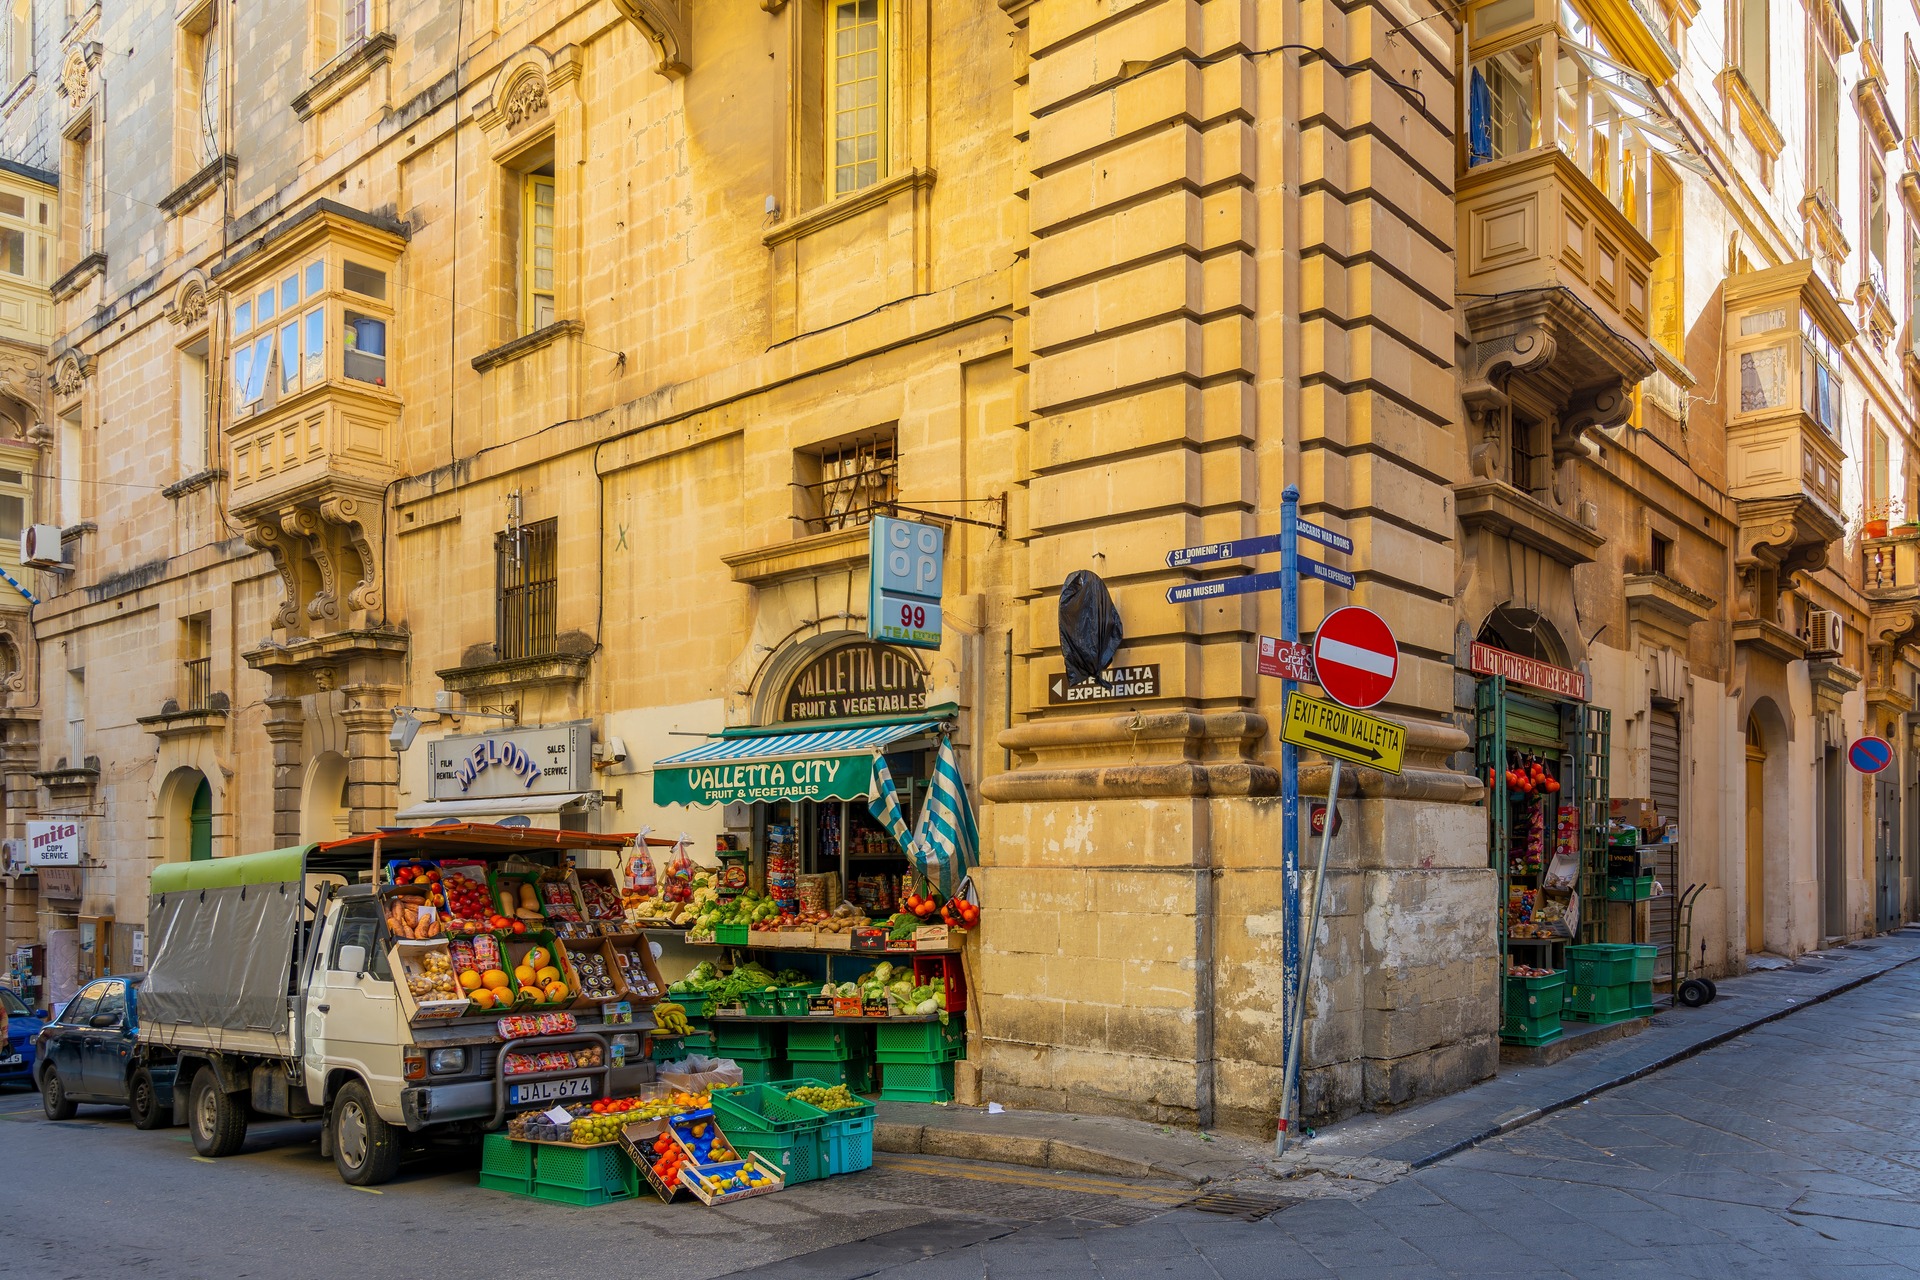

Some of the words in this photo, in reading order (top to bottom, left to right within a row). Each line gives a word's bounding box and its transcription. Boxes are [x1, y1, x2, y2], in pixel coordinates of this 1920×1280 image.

[1296, 520, 1321, 538] LASCARIS
[1321, 530, 1332, 543] WAR
[1333, 535, 1350, 550] ROOMS
[1174, 550, 1183, 560] ST
[1186, 544, 1218, 558] DOMENIC
[1174, 558, 1191, 566] CHURCH
[1314, 564, 1327, 577] MALTA
[1327, 567, 1352, 586] EXPERIENCE
[1175, 588, 1192, 599] WAR
[1193, 583, 1225, 597] MUSEUM
[900, 604, 925, 629] 99
[883, 626, 910, 640] TEA
[1278, 647, 1305, 665] Great
[1474, 645, 1503, 675] VALLETTA
[1503, 654, 1517, 680] CITY
[1517, 658, 1534, 684] FRESH
[798, 648, 876, 698] VALLETTA
[881, 651, 921, 690] CITY
[1101, 667, 1153, 683] MALTA
[791, 700, 827, 719] FRUIT
[829, 700, 837, 717] &
[842, 692, 926, 715] VEGETABLES
[1293, 698, 1318, 725] EXIT
[1319, 707, 1349, 736] FROM
[1351, 716, 1399, 752] VALLETTA
[547, 744, 566, 754] SALES
[440, 759, 453, 768] FILM
[454, 740, 541, 792] MELODY
[543, 766, 568, 777] SERVICE
[688, 763, 785, 790] VALLETTA
[792, 759, 840, 783] CITY
[705, 789, 733, 800] FRUIT
[737, 788, 746, 798] &
[748, 785, 819, 797] VEGETABLES
[32, 824, 76, 849] mita
[41, 852, 69, 860] SERVICE
[46, 844, 63, 852] COPY
[627, 1144, 648, 1173] MONNA
[648, 1167, 664, 1193] LISA
